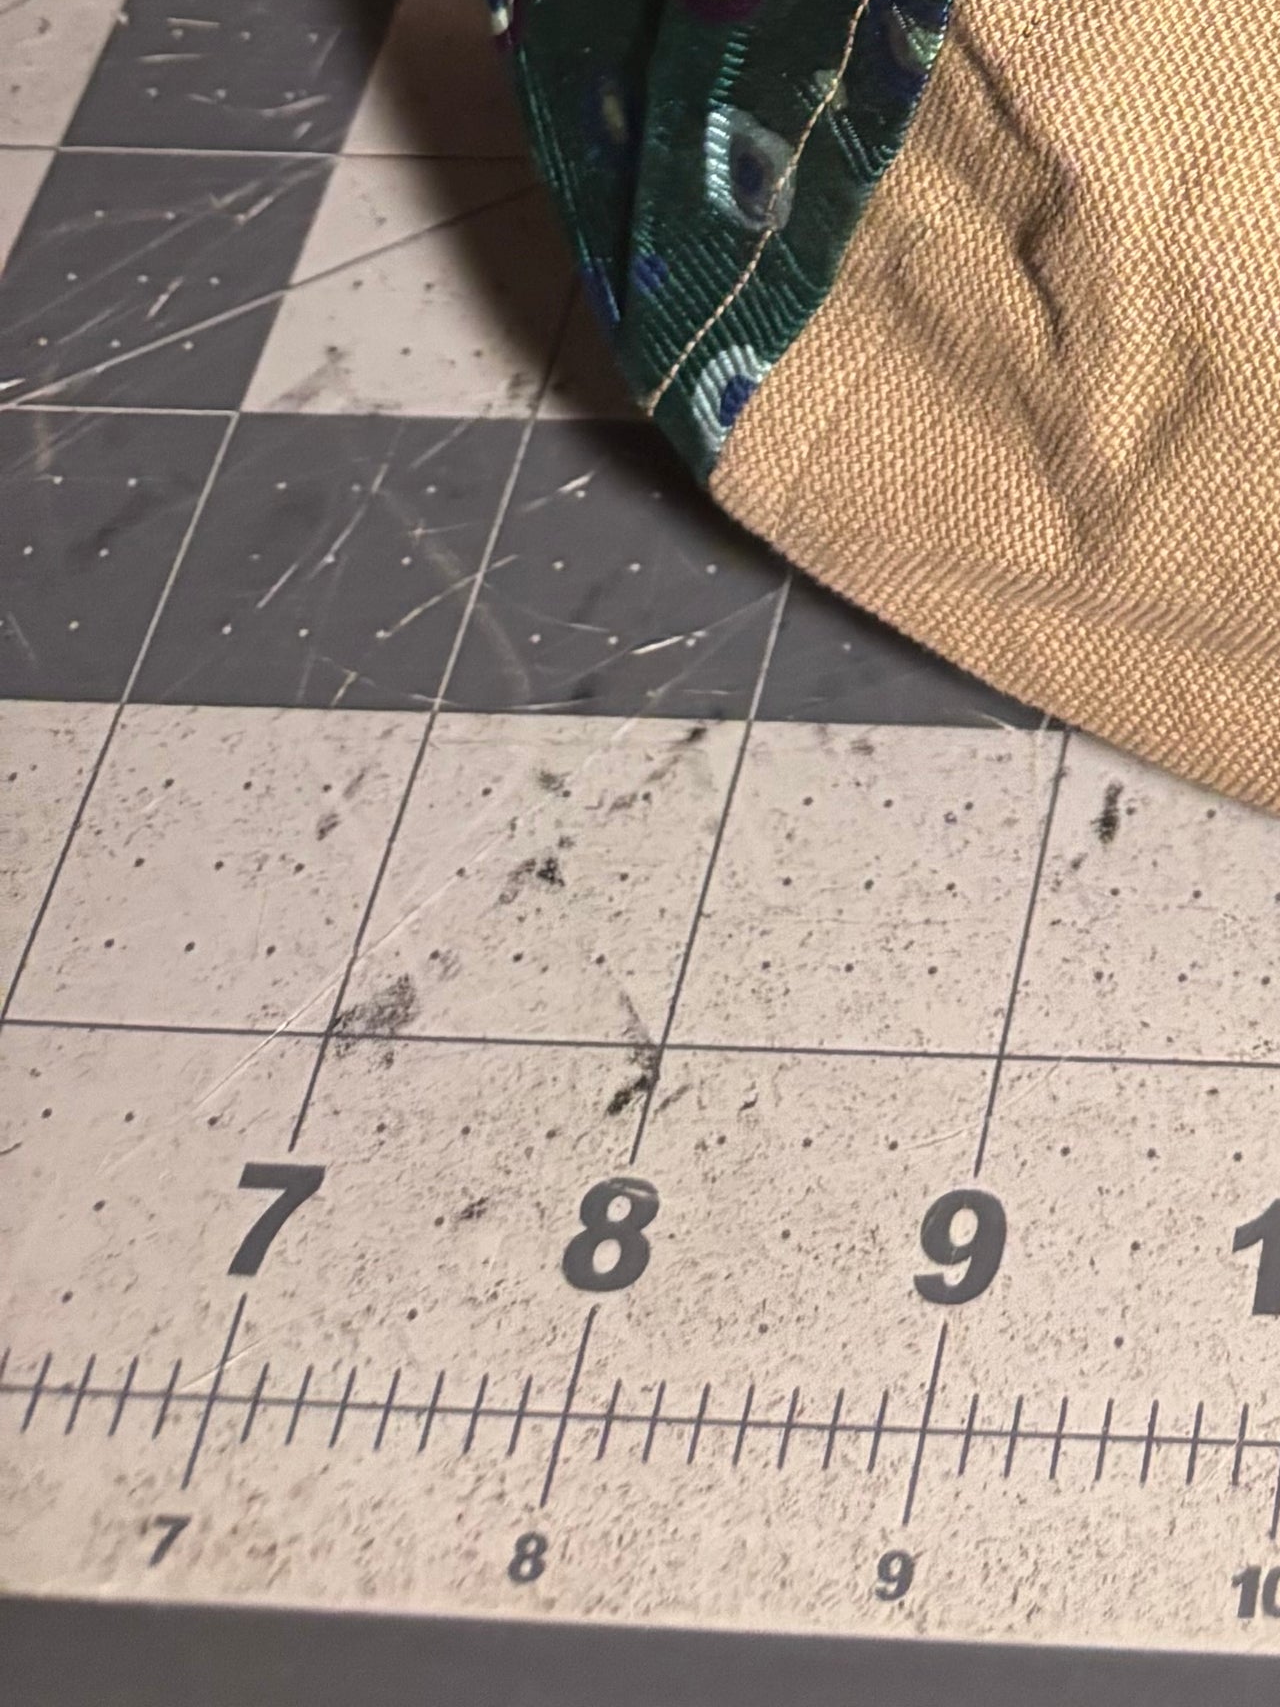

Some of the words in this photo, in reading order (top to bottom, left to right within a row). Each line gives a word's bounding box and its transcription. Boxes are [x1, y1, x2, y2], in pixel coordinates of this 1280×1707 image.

[228, 1163, 326, 1276] 7
[563, 1177, 659, 1292] 8
[914, 1189, 1007, 1304] 9
[148, 1516, 190, 1566] 7
[508, 1533, 548, 1583] 8
[876, 1551, 915, 1601] 9
